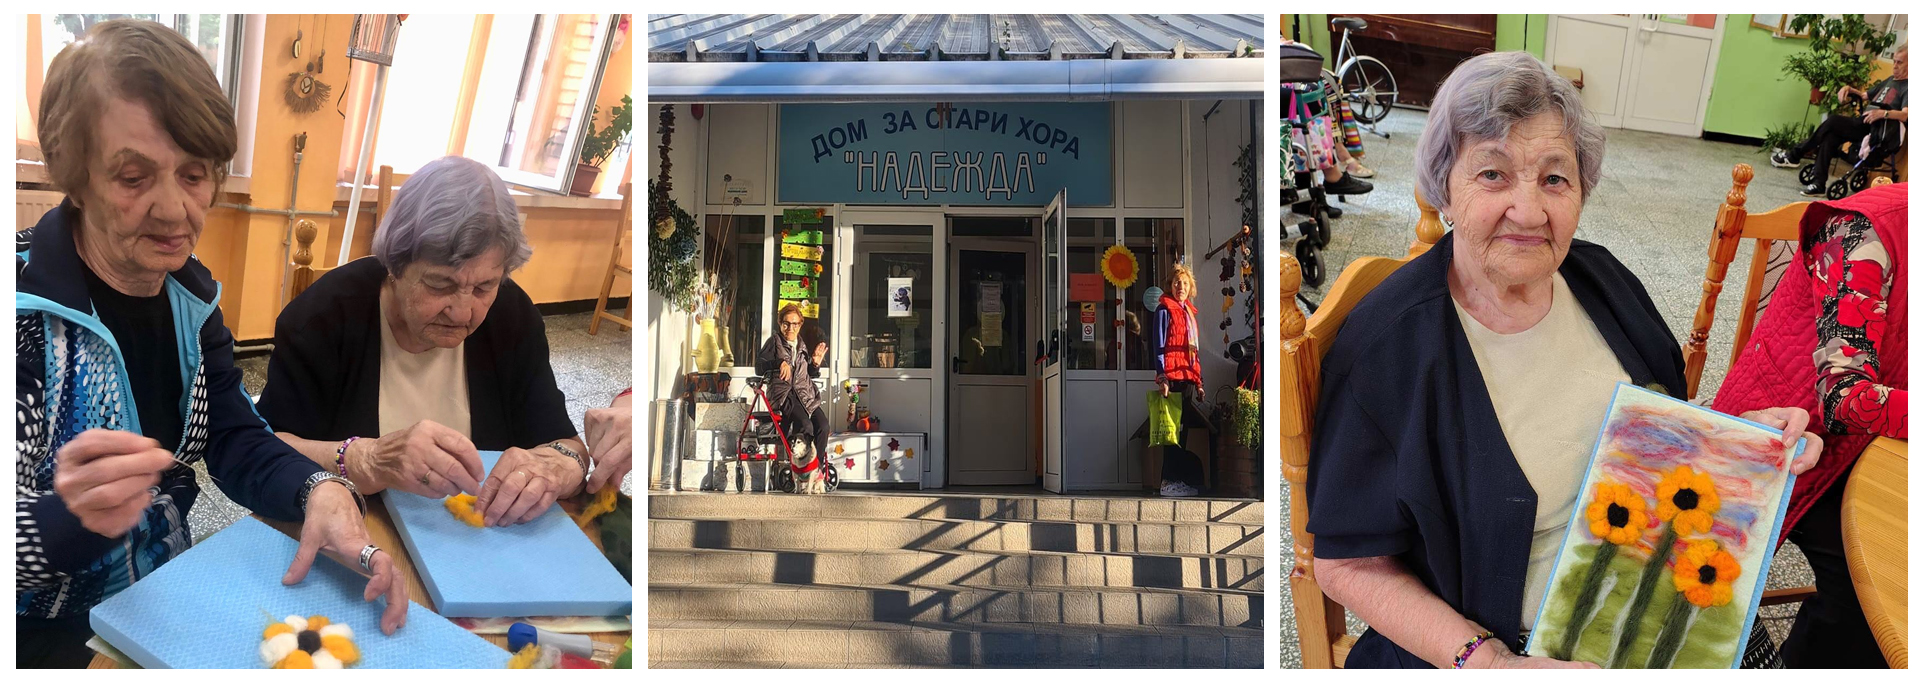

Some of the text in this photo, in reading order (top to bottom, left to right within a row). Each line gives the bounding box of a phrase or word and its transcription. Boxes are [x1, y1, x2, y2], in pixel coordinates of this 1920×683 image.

[811, 107, 1080, 163] ДОМ ЗА СТАРИ ХОРА
[844, 151, 1047, 200] "НАДЕЖДА"
